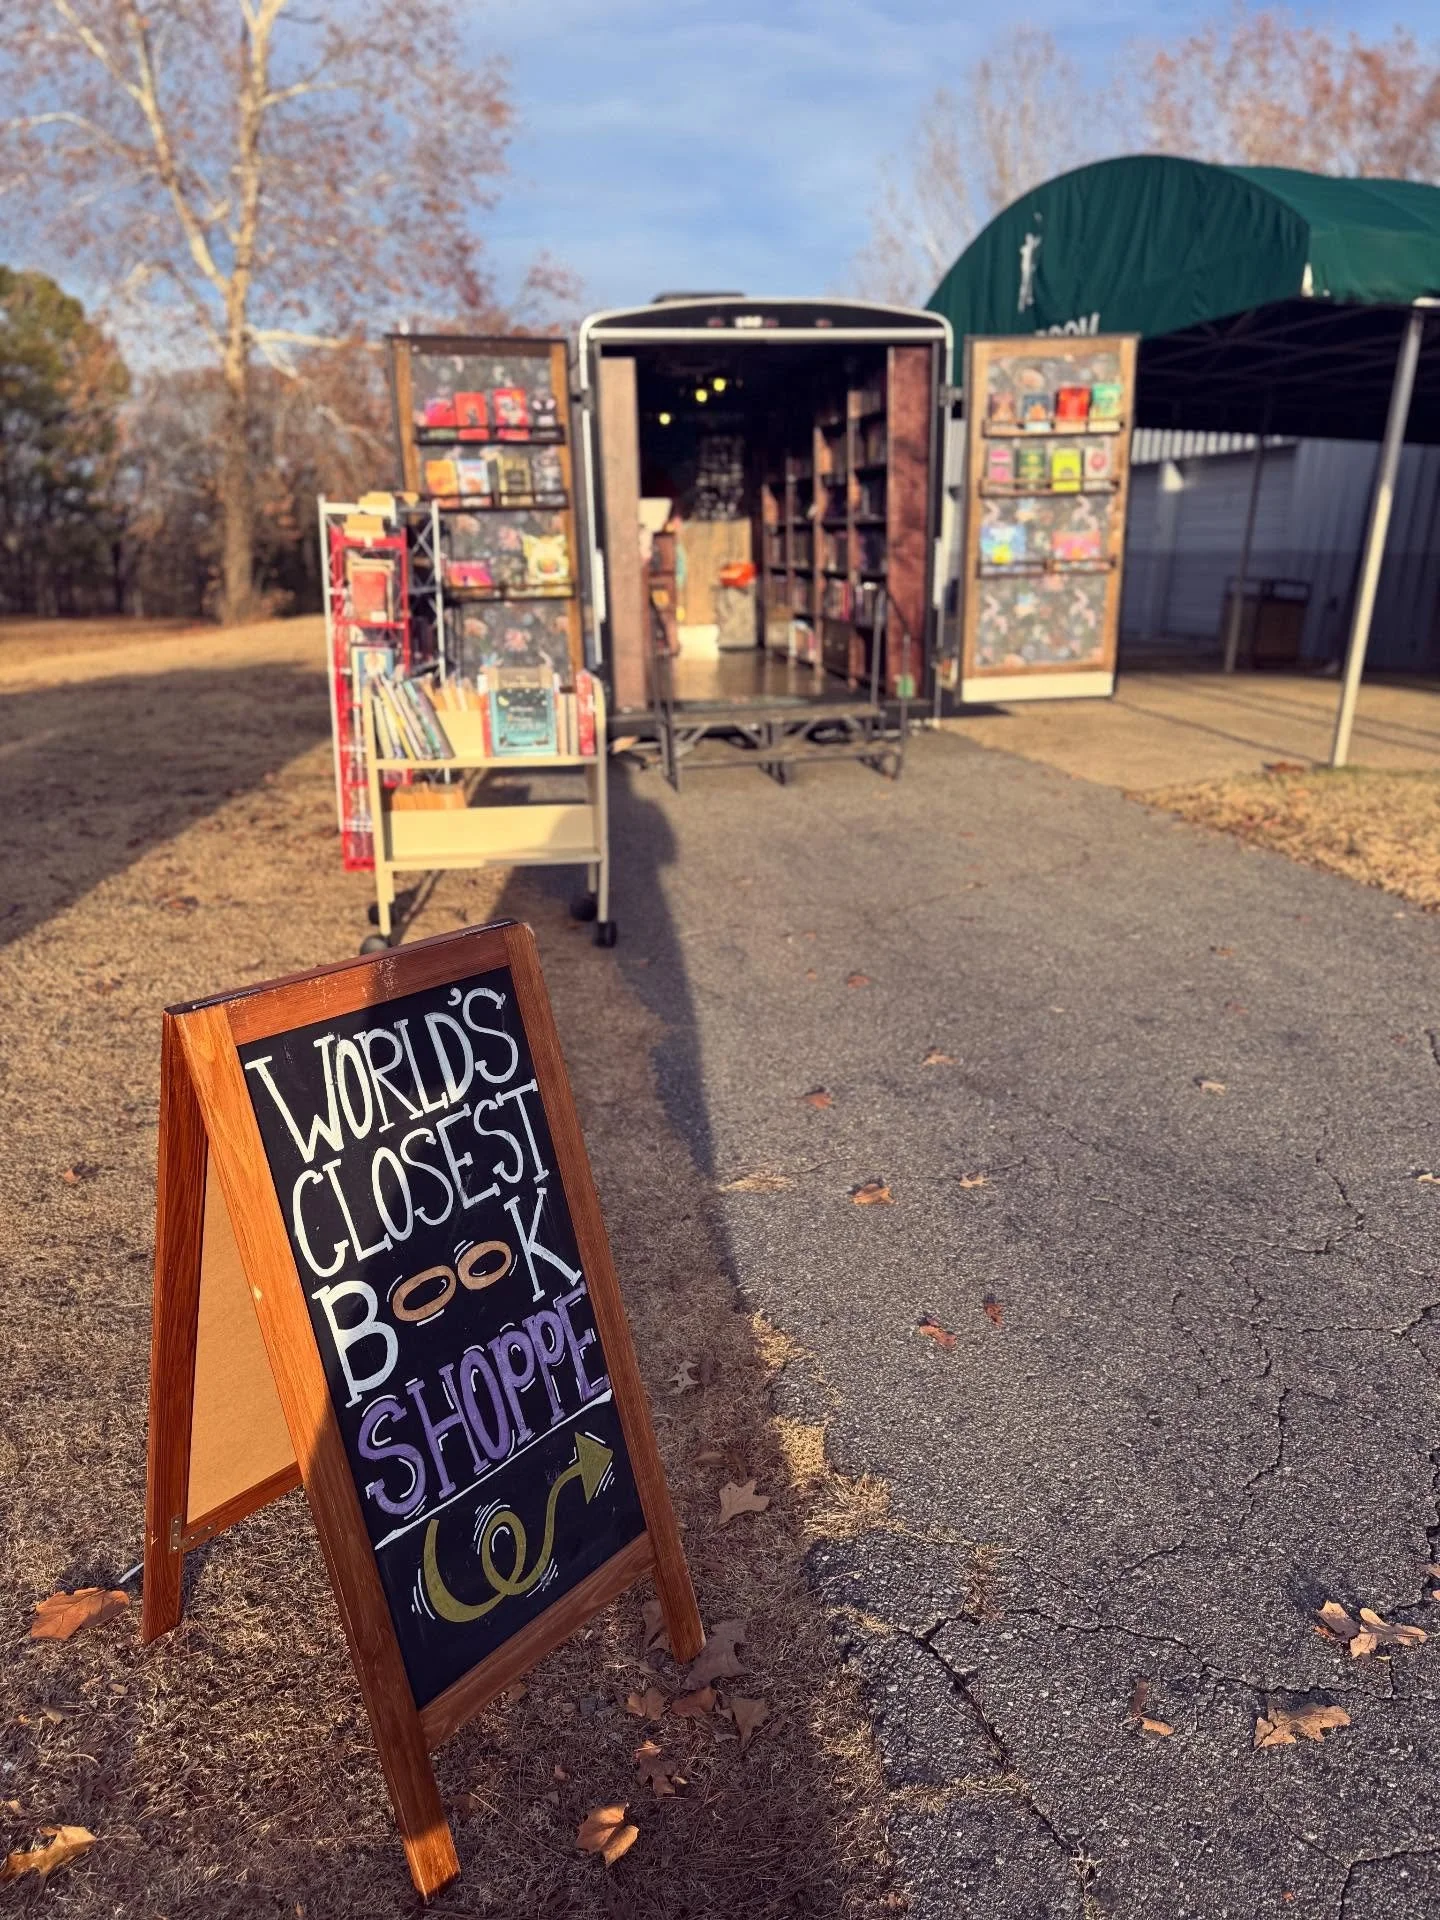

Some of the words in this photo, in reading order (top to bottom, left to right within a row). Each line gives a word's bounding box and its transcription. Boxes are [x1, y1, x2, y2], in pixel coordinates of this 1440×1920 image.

[245, 988, 519, 1163] WORLD'S
[292, 1079, 549, 1277] CLOSEST
[312, 1188, 582, 1407] BOOK
[358, 1281, 612, 1515] SHOPPE
